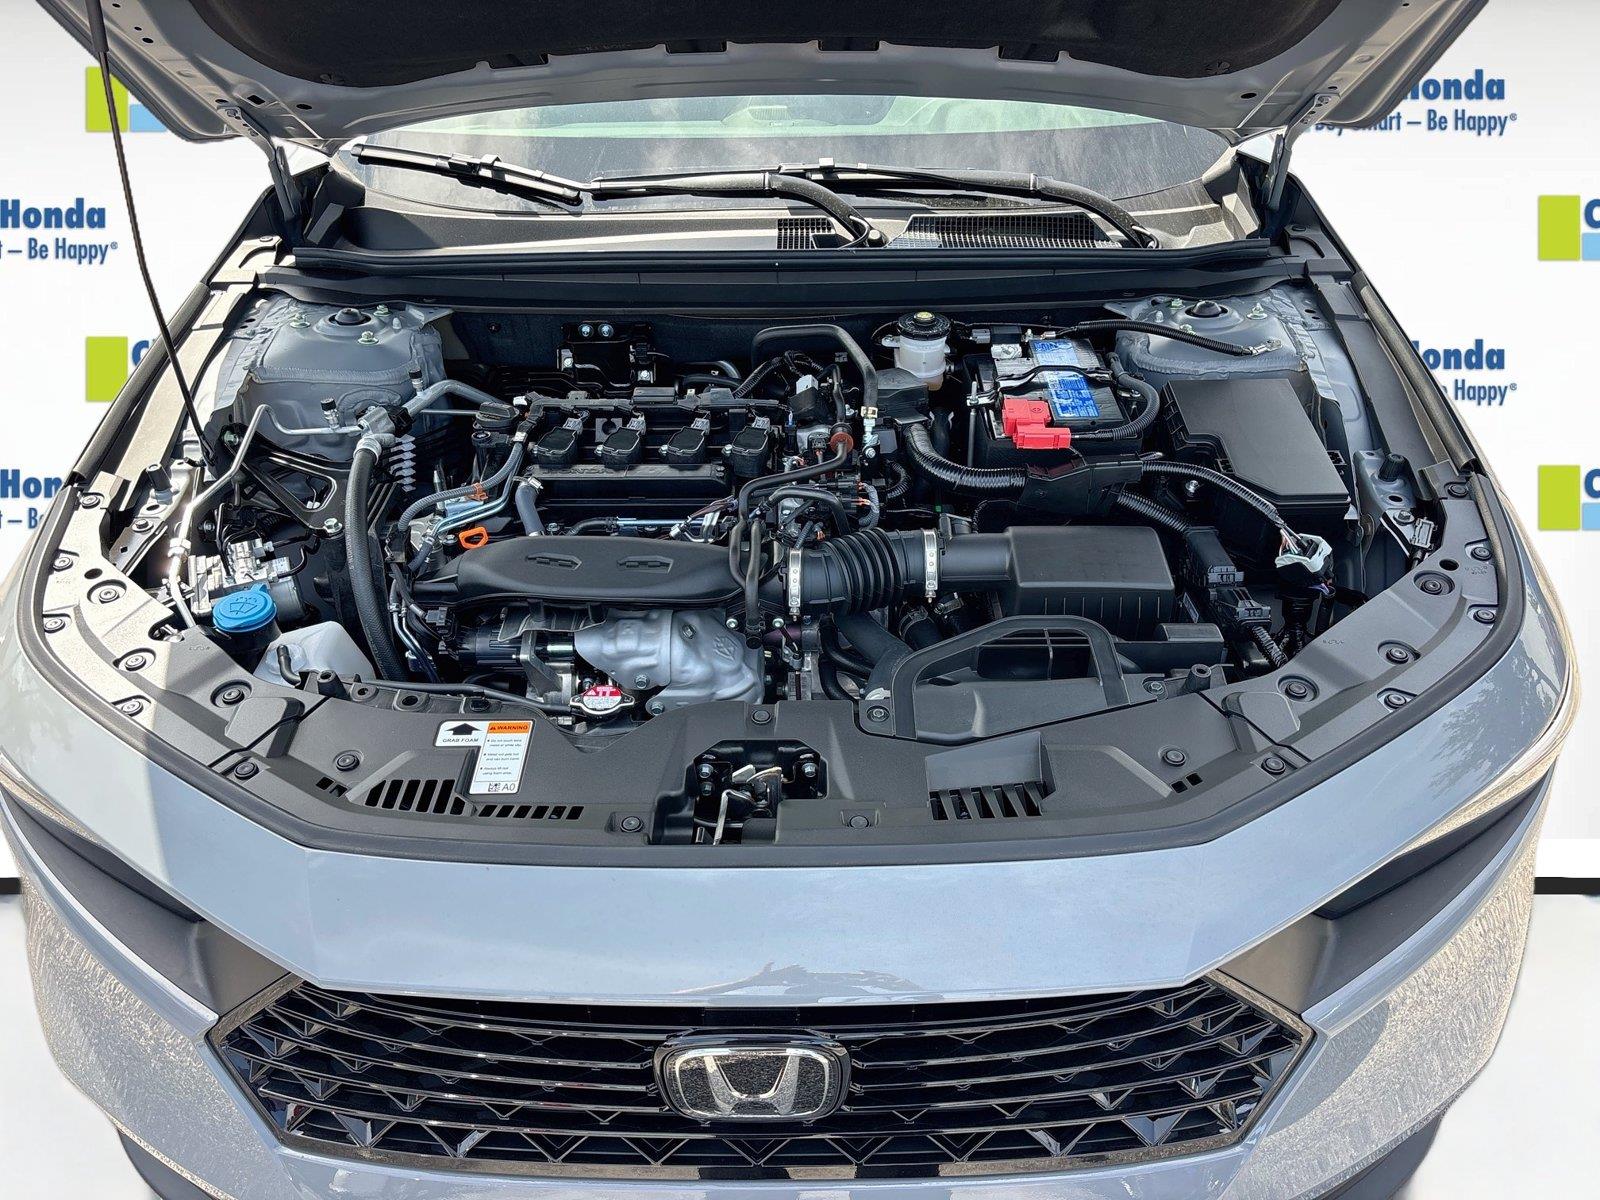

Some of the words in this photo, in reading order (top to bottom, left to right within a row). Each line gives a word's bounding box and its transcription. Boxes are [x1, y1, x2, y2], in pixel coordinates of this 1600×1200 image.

[1427, 109, 1448, 131] Be
[0, 198, 105, 229] Honda
[28, 238, 48, 259] Be
